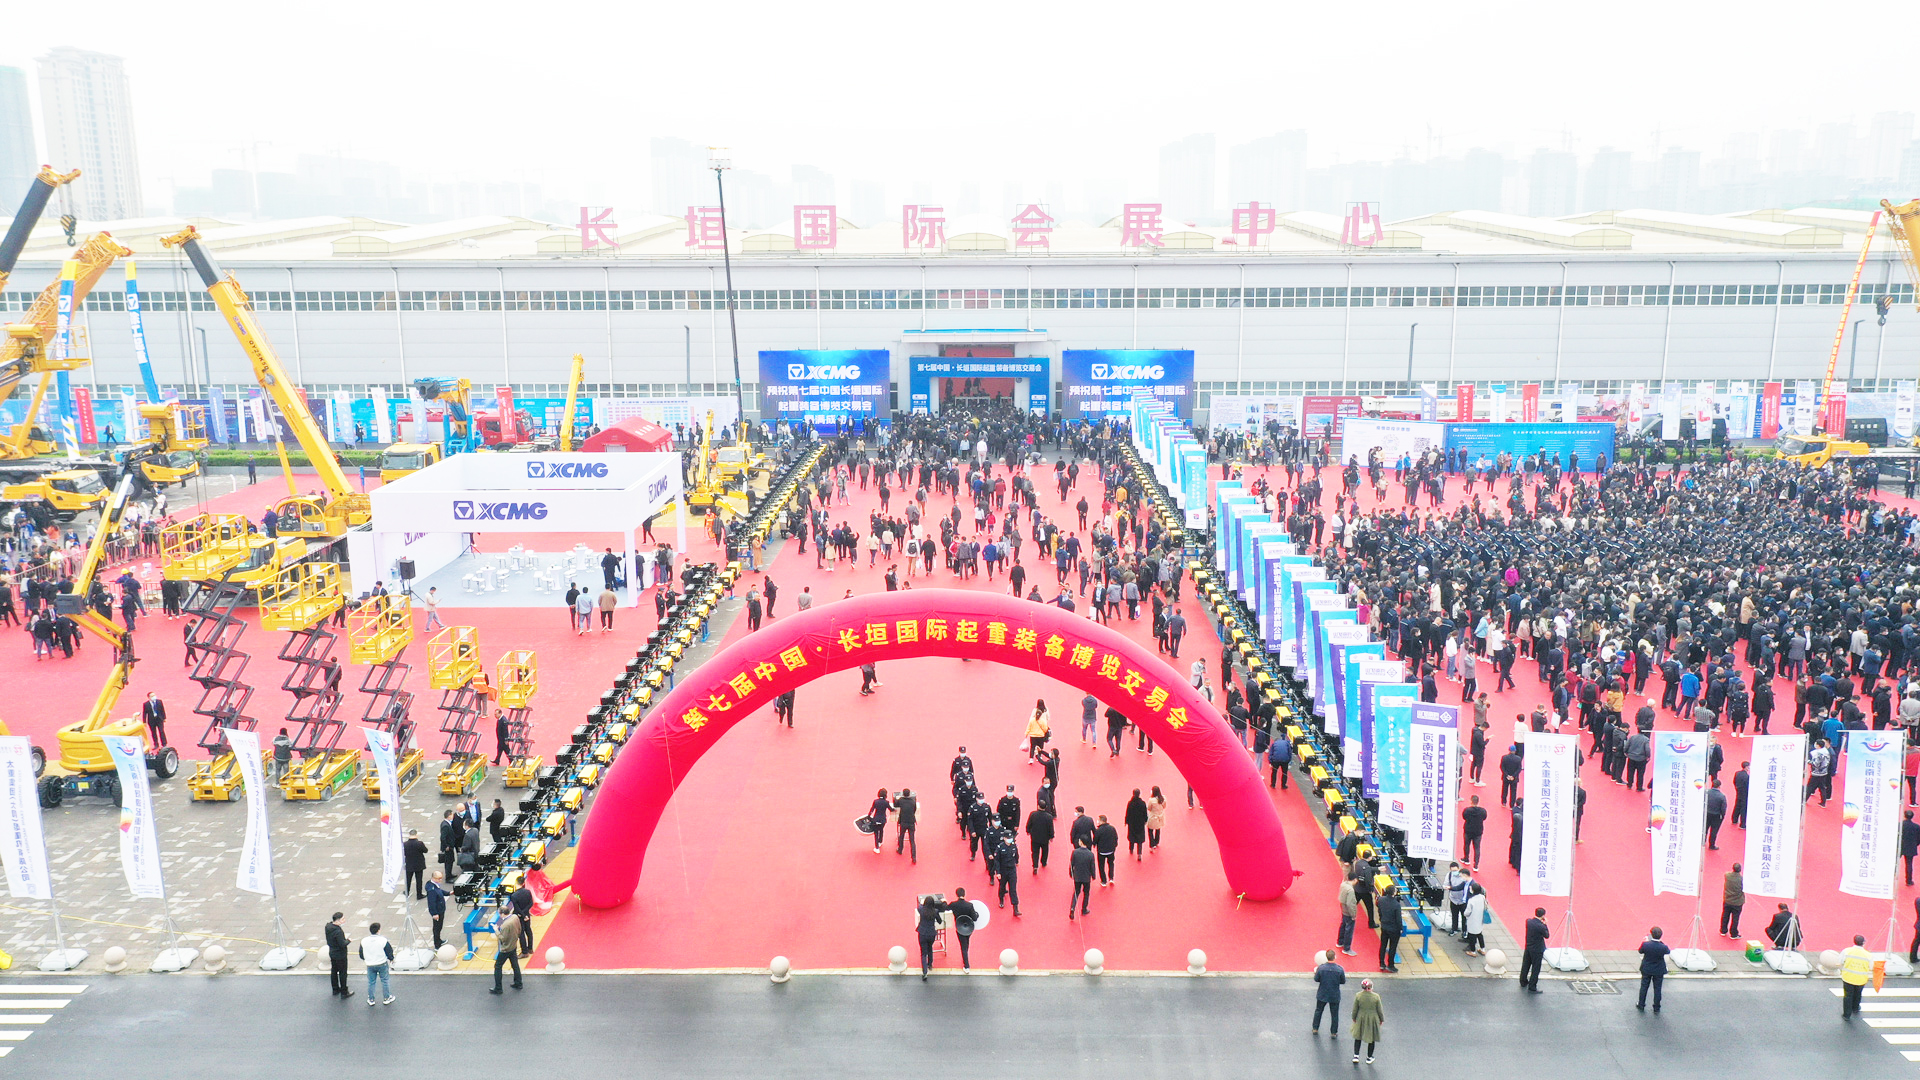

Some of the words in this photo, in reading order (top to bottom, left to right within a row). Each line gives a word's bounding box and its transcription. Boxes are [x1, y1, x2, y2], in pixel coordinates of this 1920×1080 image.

[576, 201, 1383, 250] 长垣国际会展中心
[805, 364, 860, 380] XCMG
[1108, 364, 1164, 380] XCMG
[767, 385, 882, 396] 预祝第七届中国长垣国际
[778, 401, 872, 412] 起重装备博览交易会
[547, 462, 608, 478] XCMG
[654, 474, 668, 500] XCMG
[476, 502, 548, 520] XCMG
[682, 618, 1190, 733] 第七届中国·长垣国际起重装备博览交易会
